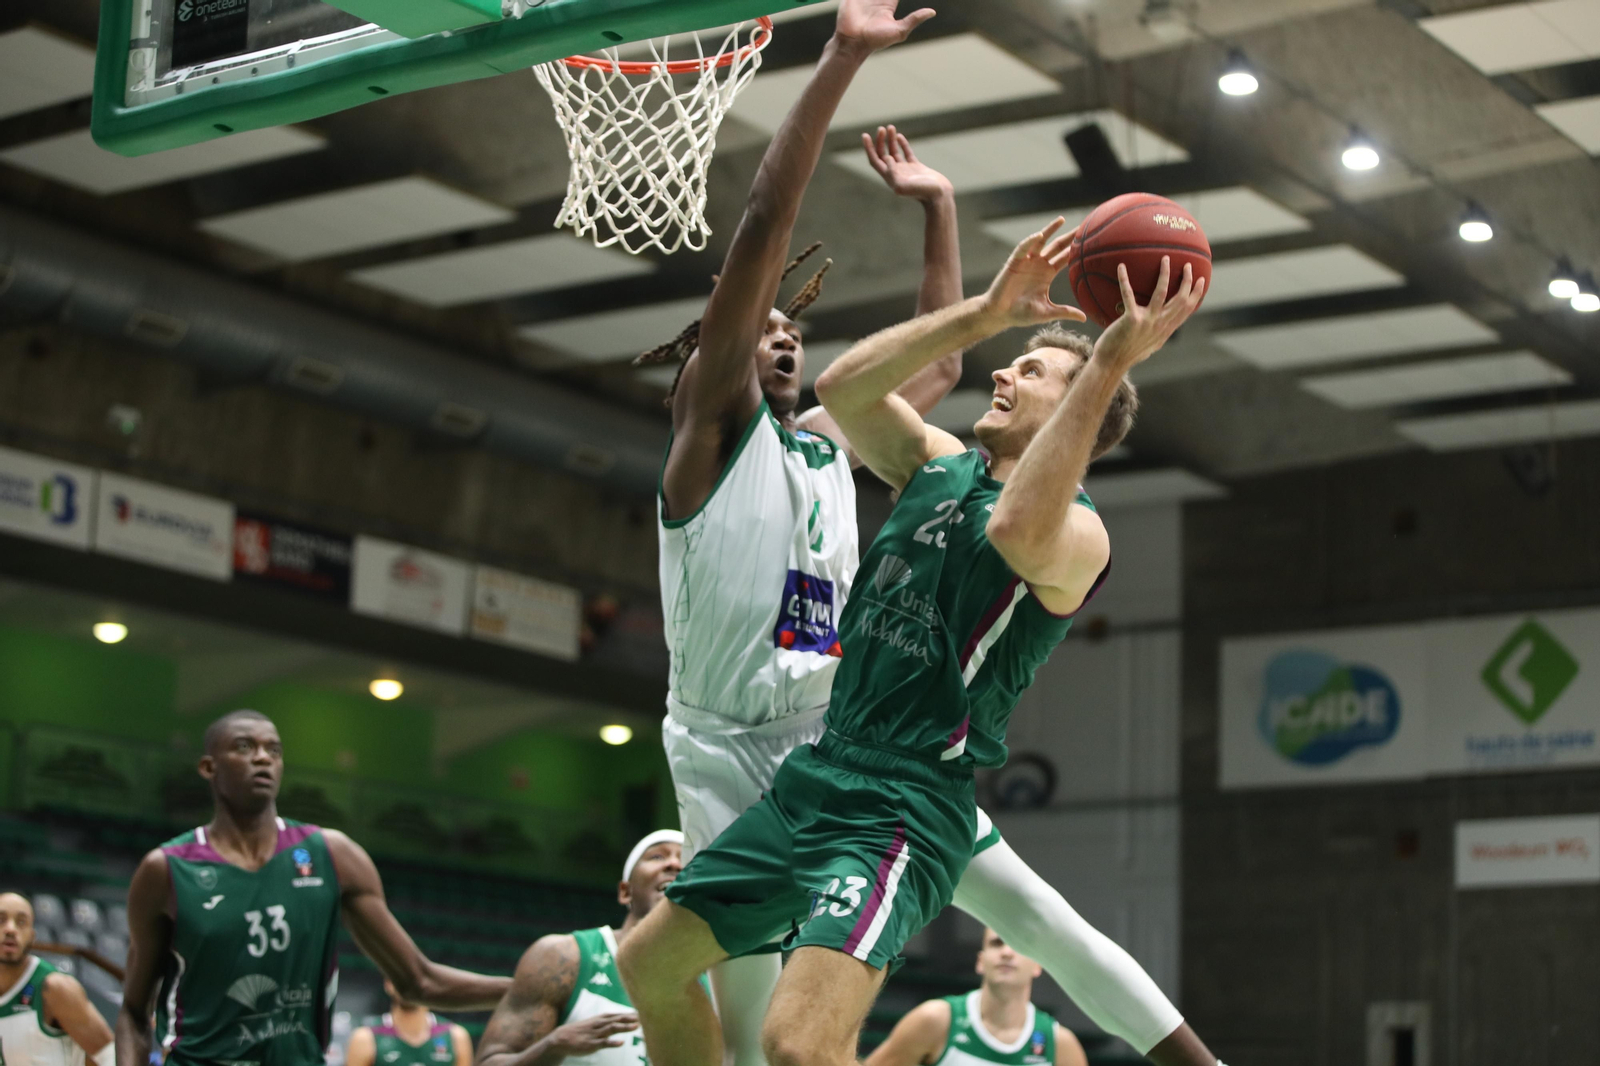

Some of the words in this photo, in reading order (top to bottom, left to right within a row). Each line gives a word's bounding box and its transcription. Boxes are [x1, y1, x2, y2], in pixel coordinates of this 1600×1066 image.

[1269, 688, 1388, 730] ICADE
[812, 876, 868, 918] 23
[244, 904, 291, 958] 33
